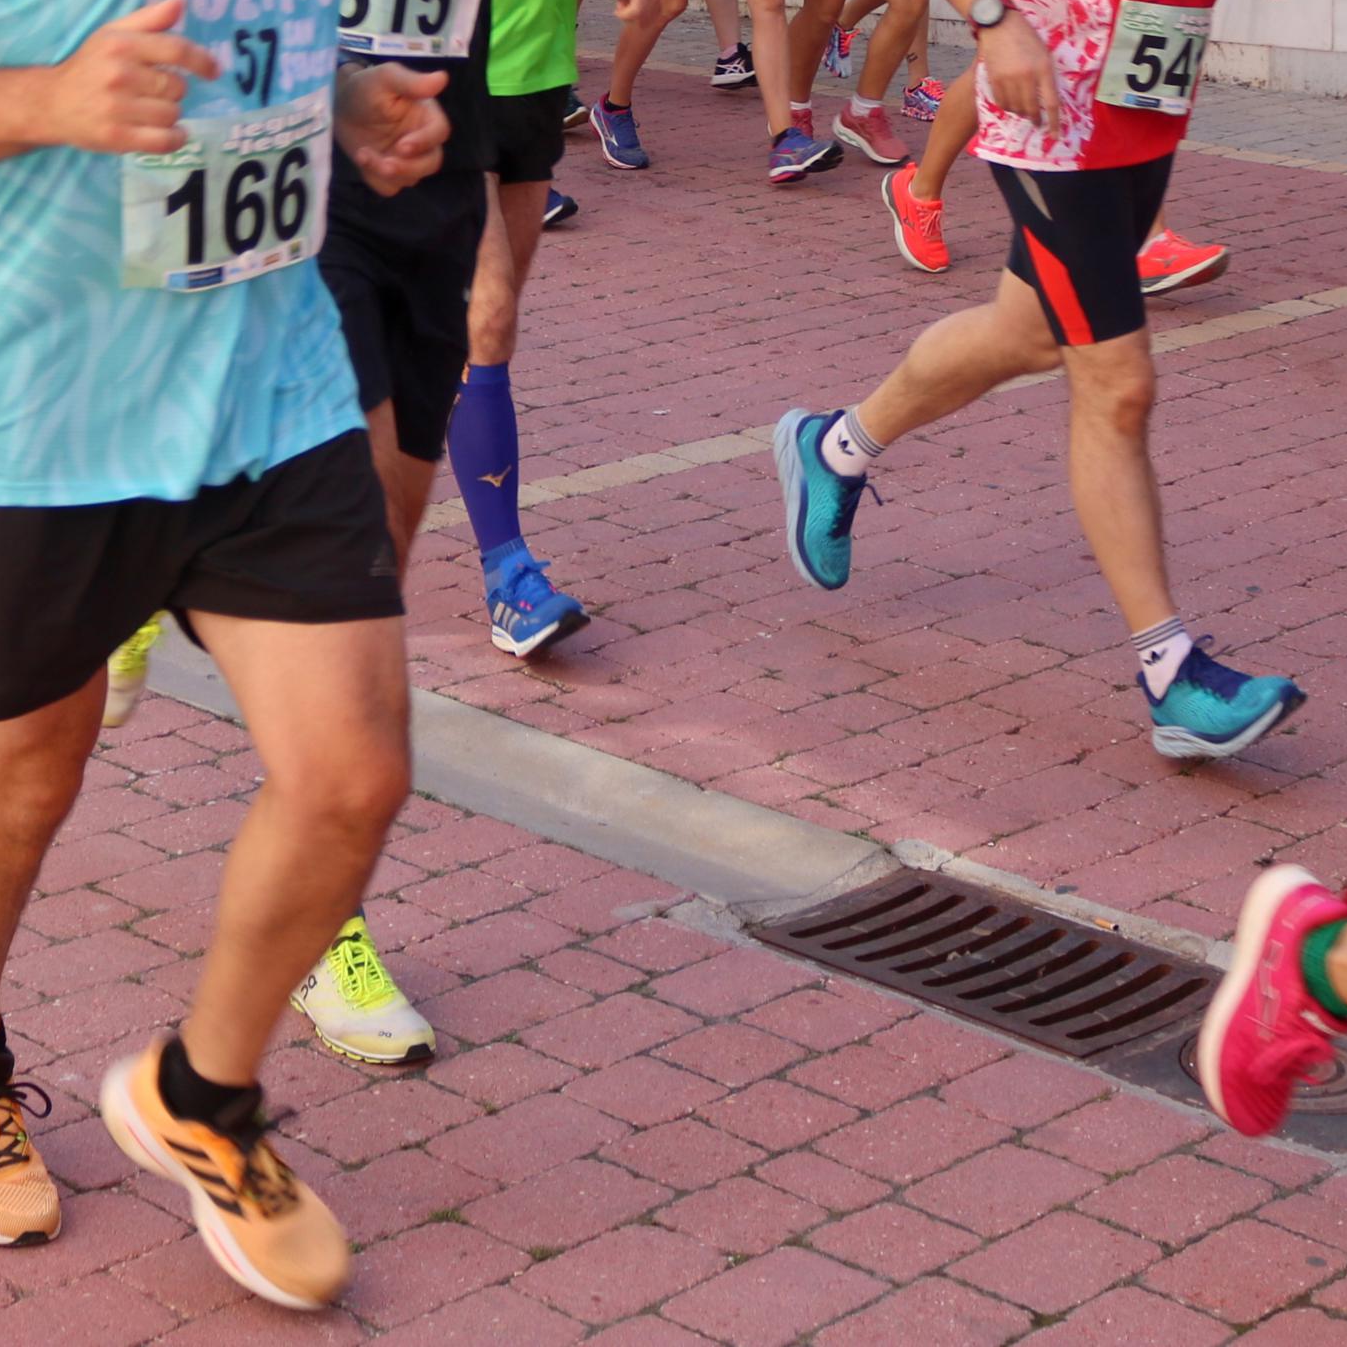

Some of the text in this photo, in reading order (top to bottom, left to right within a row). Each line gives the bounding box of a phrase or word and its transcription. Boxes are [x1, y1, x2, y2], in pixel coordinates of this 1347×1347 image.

[235, 27, 279, 107] 57
[1125, 34, 1205, 97] 54
[166, 146, 309, 266] 166
